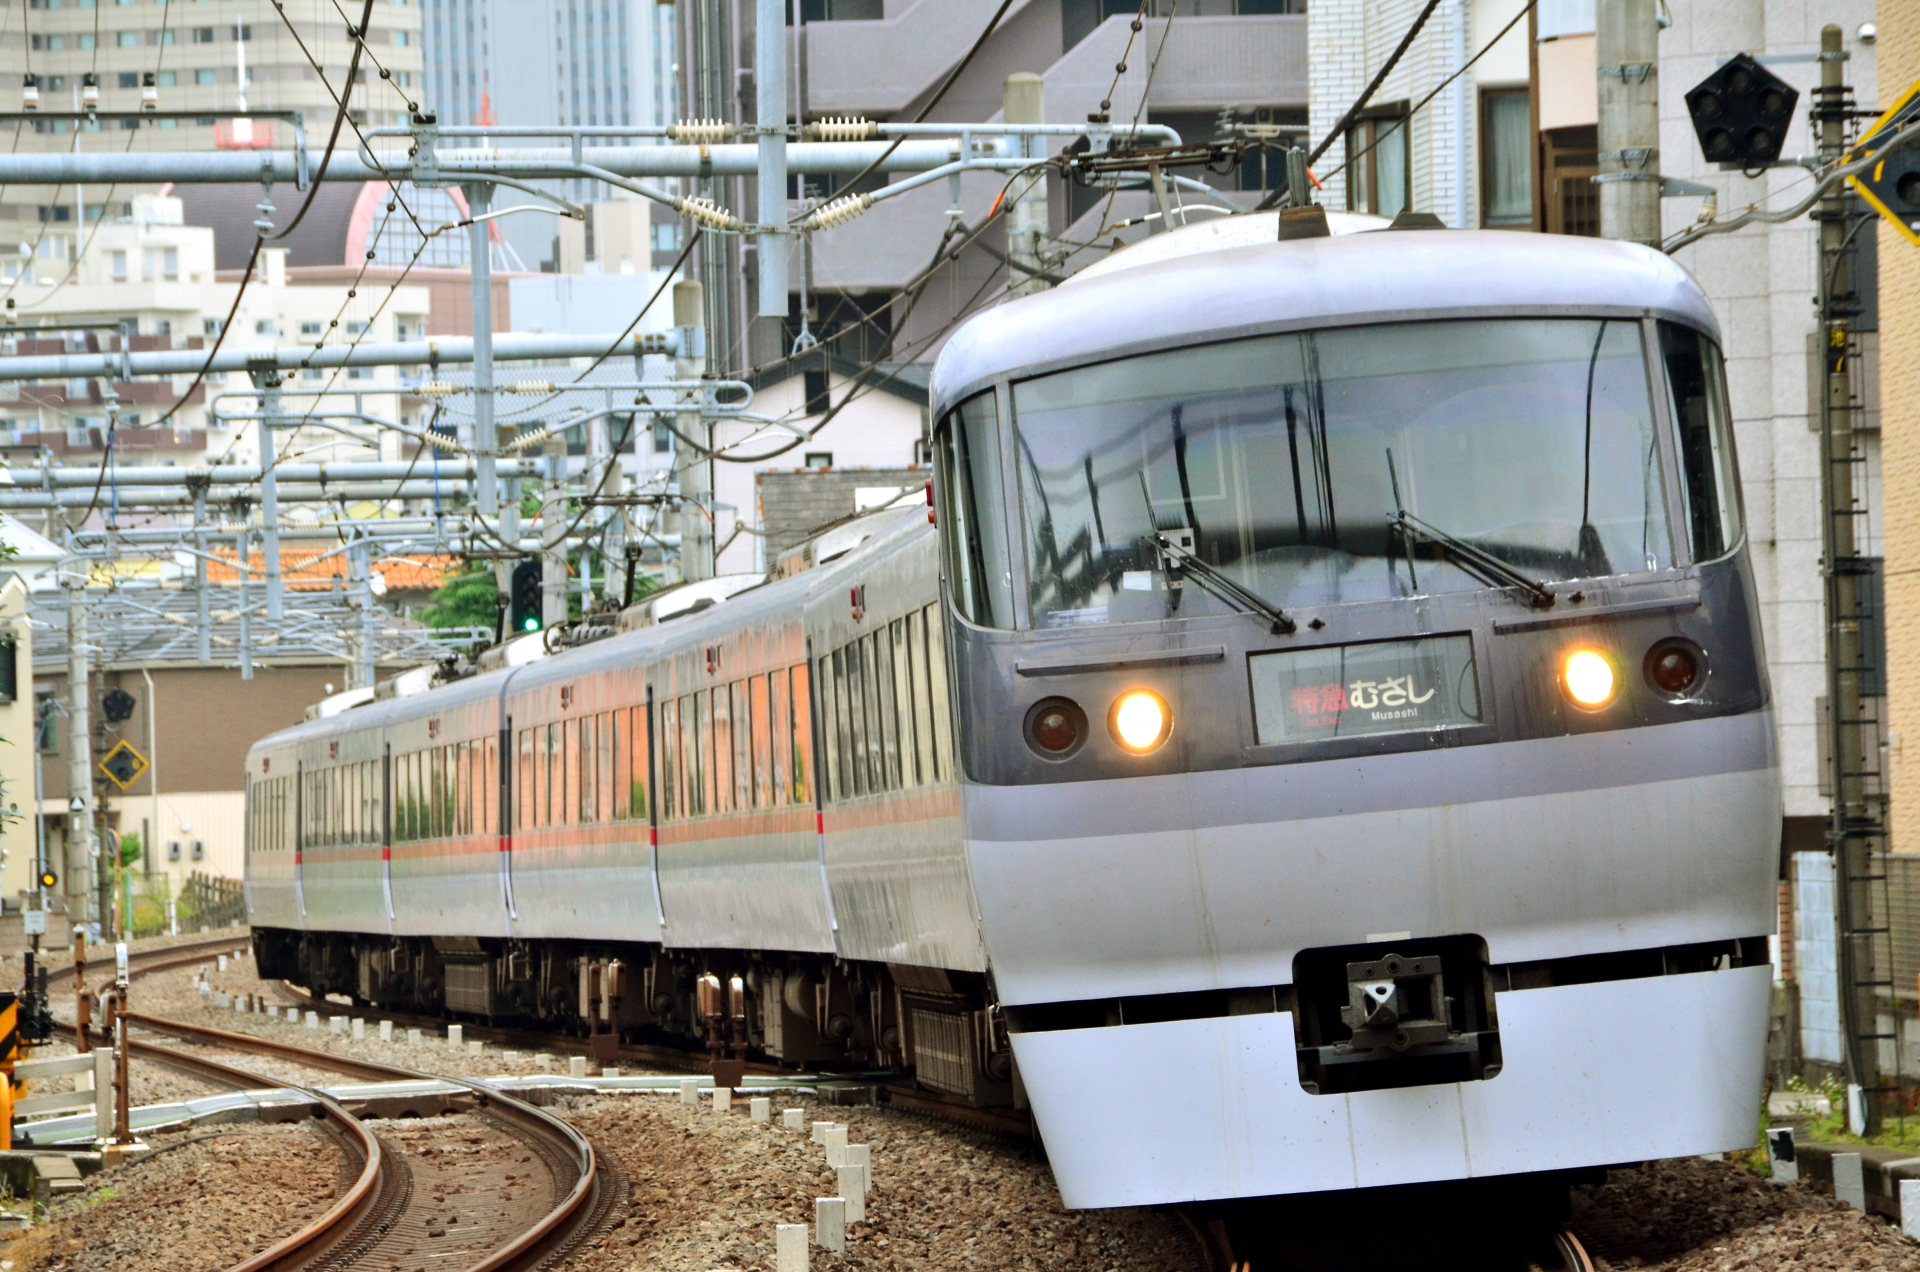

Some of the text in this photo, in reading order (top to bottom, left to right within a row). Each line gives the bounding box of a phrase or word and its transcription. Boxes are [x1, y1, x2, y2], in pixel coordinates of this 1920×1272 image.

[1291, 674, 1435, 715] 特急 むさし
[1371, 707, 1418, 720] Musashi
